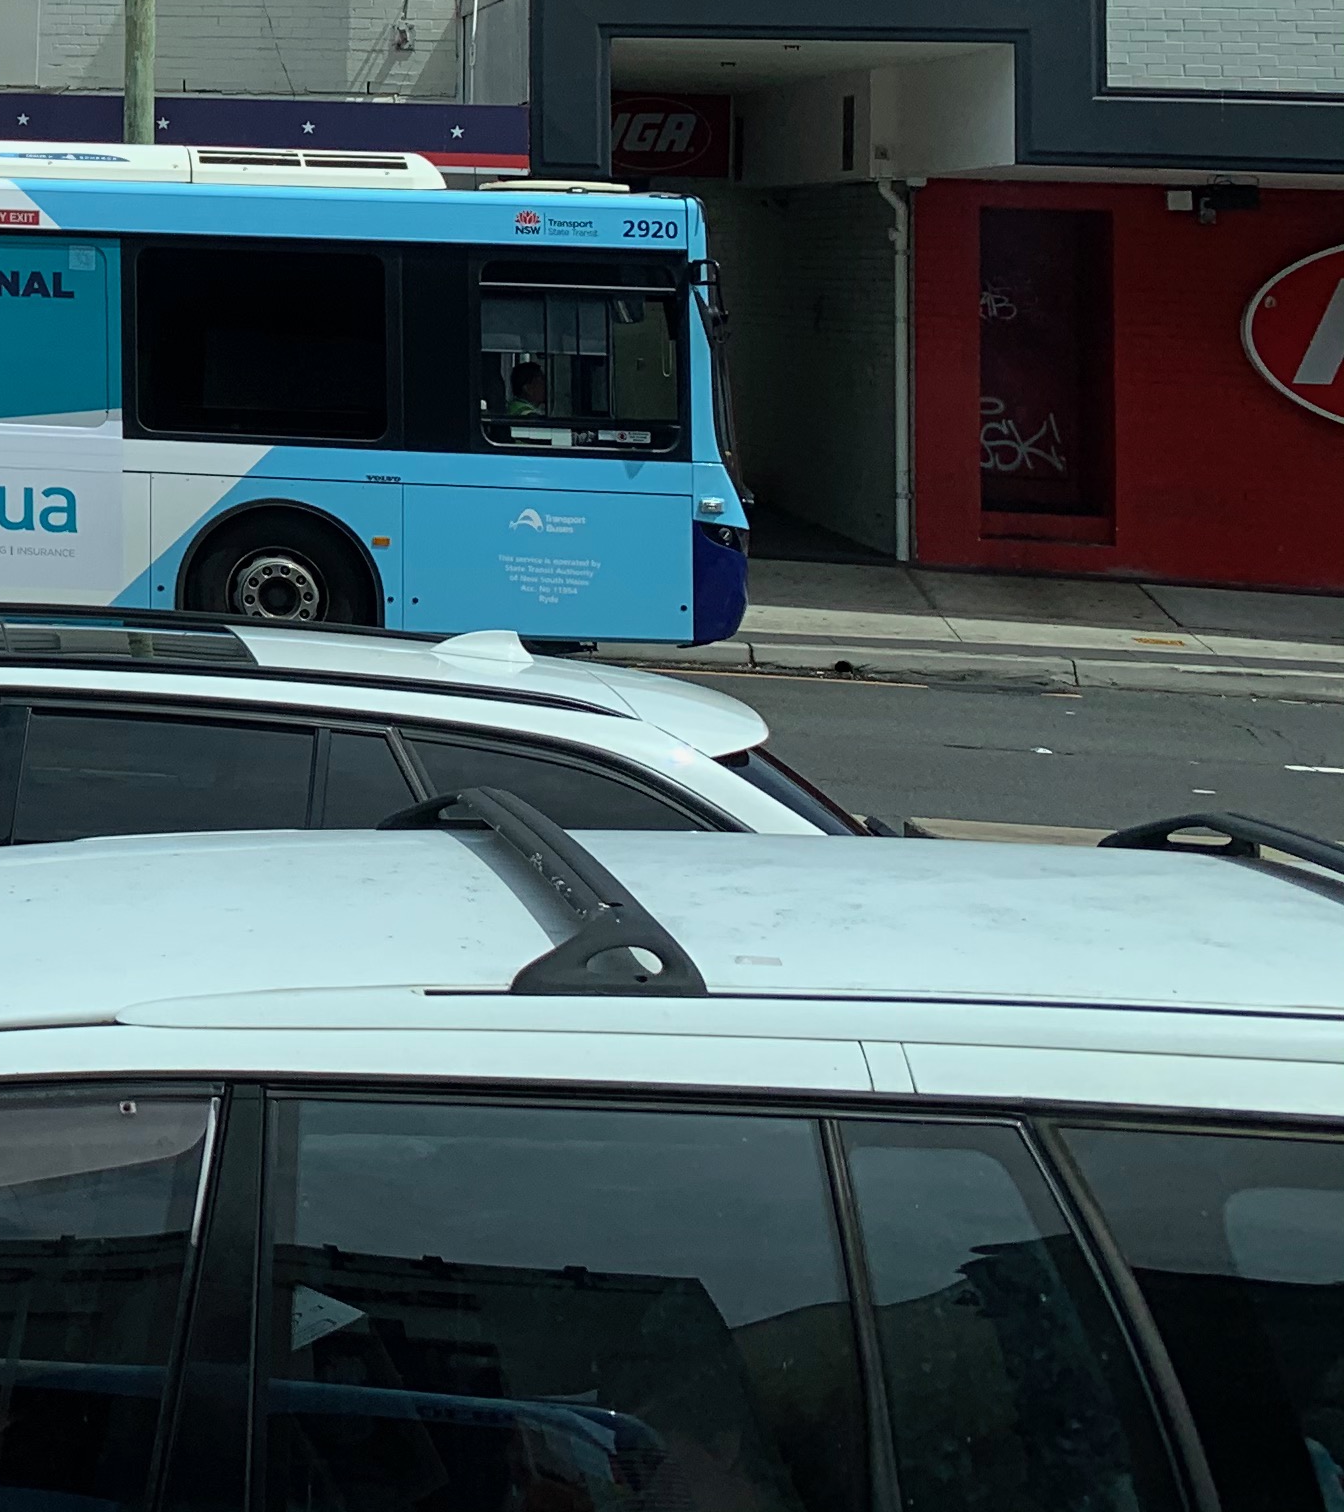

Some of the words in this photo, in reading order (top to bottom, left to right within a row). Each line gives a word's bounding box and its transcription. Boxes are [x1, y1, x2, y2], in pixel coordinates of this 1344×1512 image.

[10, 212, 35, 223] EXIT
[548, 219, 593, 228] Transport
[515, 226, 540, 235] NSW
[548, 228, 569, 236] State
[572, 229, 598, 237] Transit
[622, 220, 678, 238] 2920
[545, 514, 586, 525] Transport
[546, 525, 573, 534] Buses
[17, 547, 75, 558] INSURANCE
[498, 554, 514, 562] This
[591, 560, 601, 569] by
[505, 564, 525, 572] State
[528, 565, 554, 573] Transit
[555, 567, 594, 578] Authority
[540, 576, 563, 584] South
[566, 578, 589, 586] Wales
[539, 594, 559, 604] Ryde
